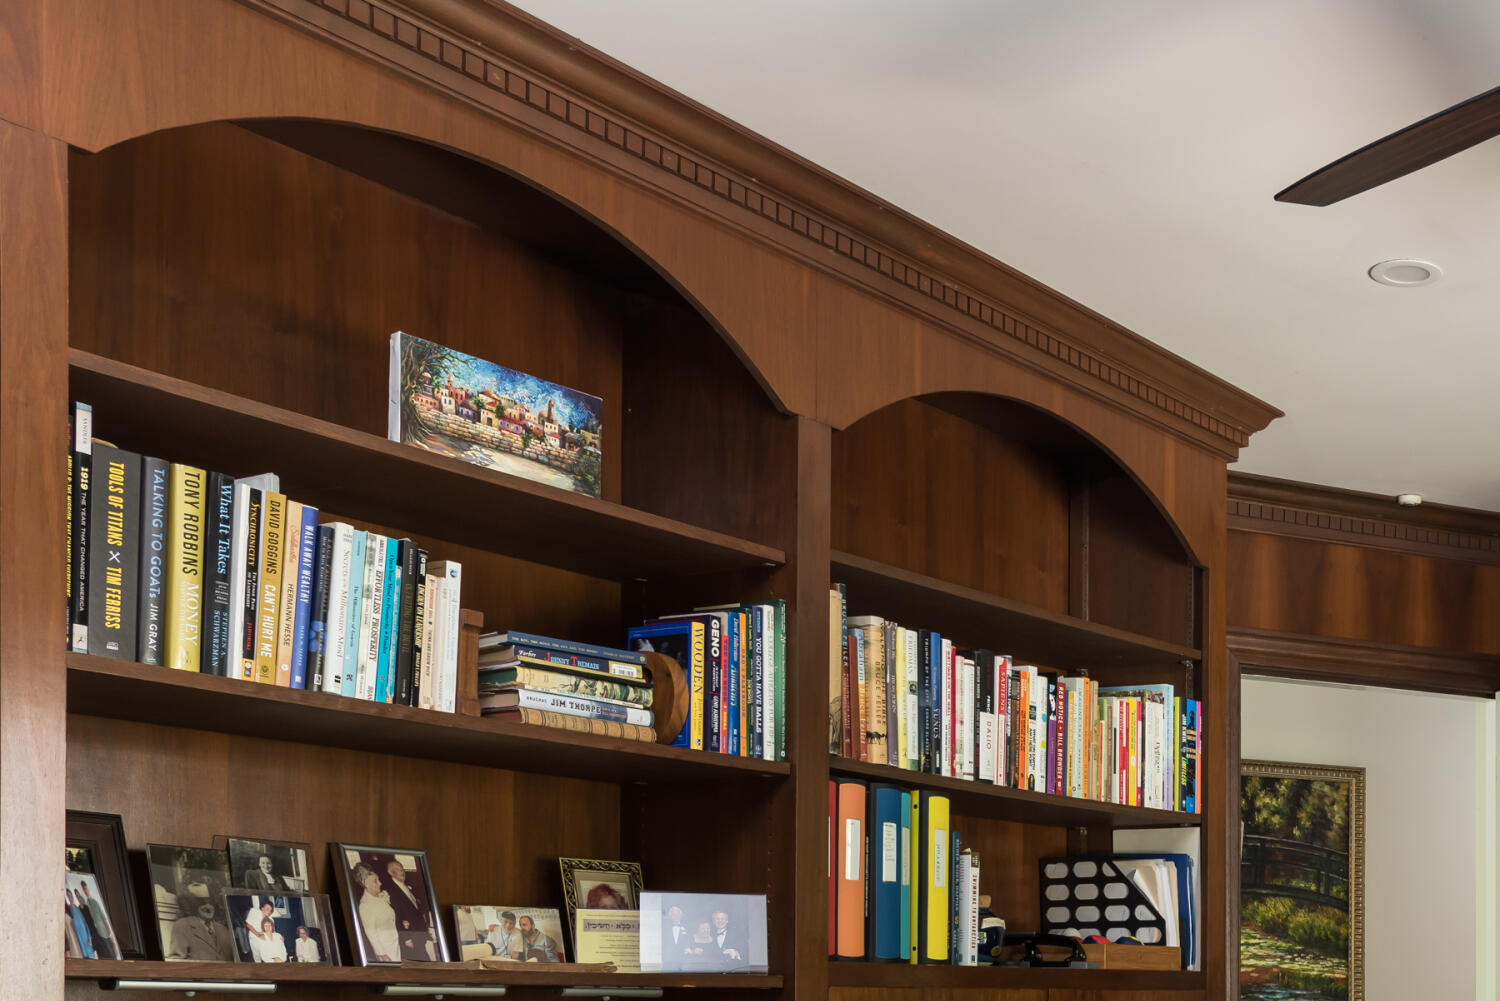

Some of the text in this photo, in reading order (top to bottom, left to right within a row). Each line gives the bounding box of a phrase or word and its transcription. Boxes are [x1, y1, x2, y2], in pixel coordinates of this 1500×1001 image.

[81, 467, 89, 489] 1919
[151, 468, 165, 529] TALKING
[219, 483, 233, 521] What
[104, 461, 125, 630] TOOLS OF TITANS TIM FERRISS
[151, 532, 163, 552] TO
[218, 524, 232, 536] It
[247, 501, 260, 567] SYNCHRONICITY
[181, 471, 201, 646] TONY ROBBINS MONEY
[217, 539, 230, 575] Takes
[299, 525, 315, 604] WALK AWAY WEALTHY
[260, 500, 281, 659] DAVID GOGGINS CAN'T HURT ME
[372, 569, 384, 614] EFFORTLESS
[149, 602, 159, 621] JIM
[283, 583, 295, 648] HERMANN HESSE
[147, 623, 159, 652] GRAY
[211, 610, 222, 668] SCHWARZMAN
[336, 634, 345, 659] Mind
[368, 617, 381, 663] PROSPERITY
[415, 616, 424, 649] LEADERSHIP
[710, 618, 720, 658] GENO
[692, 627, 705, 695] WOODEN
[550, 697, 602, 714] JIM THORPE
[755, 706, 763, 733] BALLS
[932, 707, 940, 740] YUNUS
